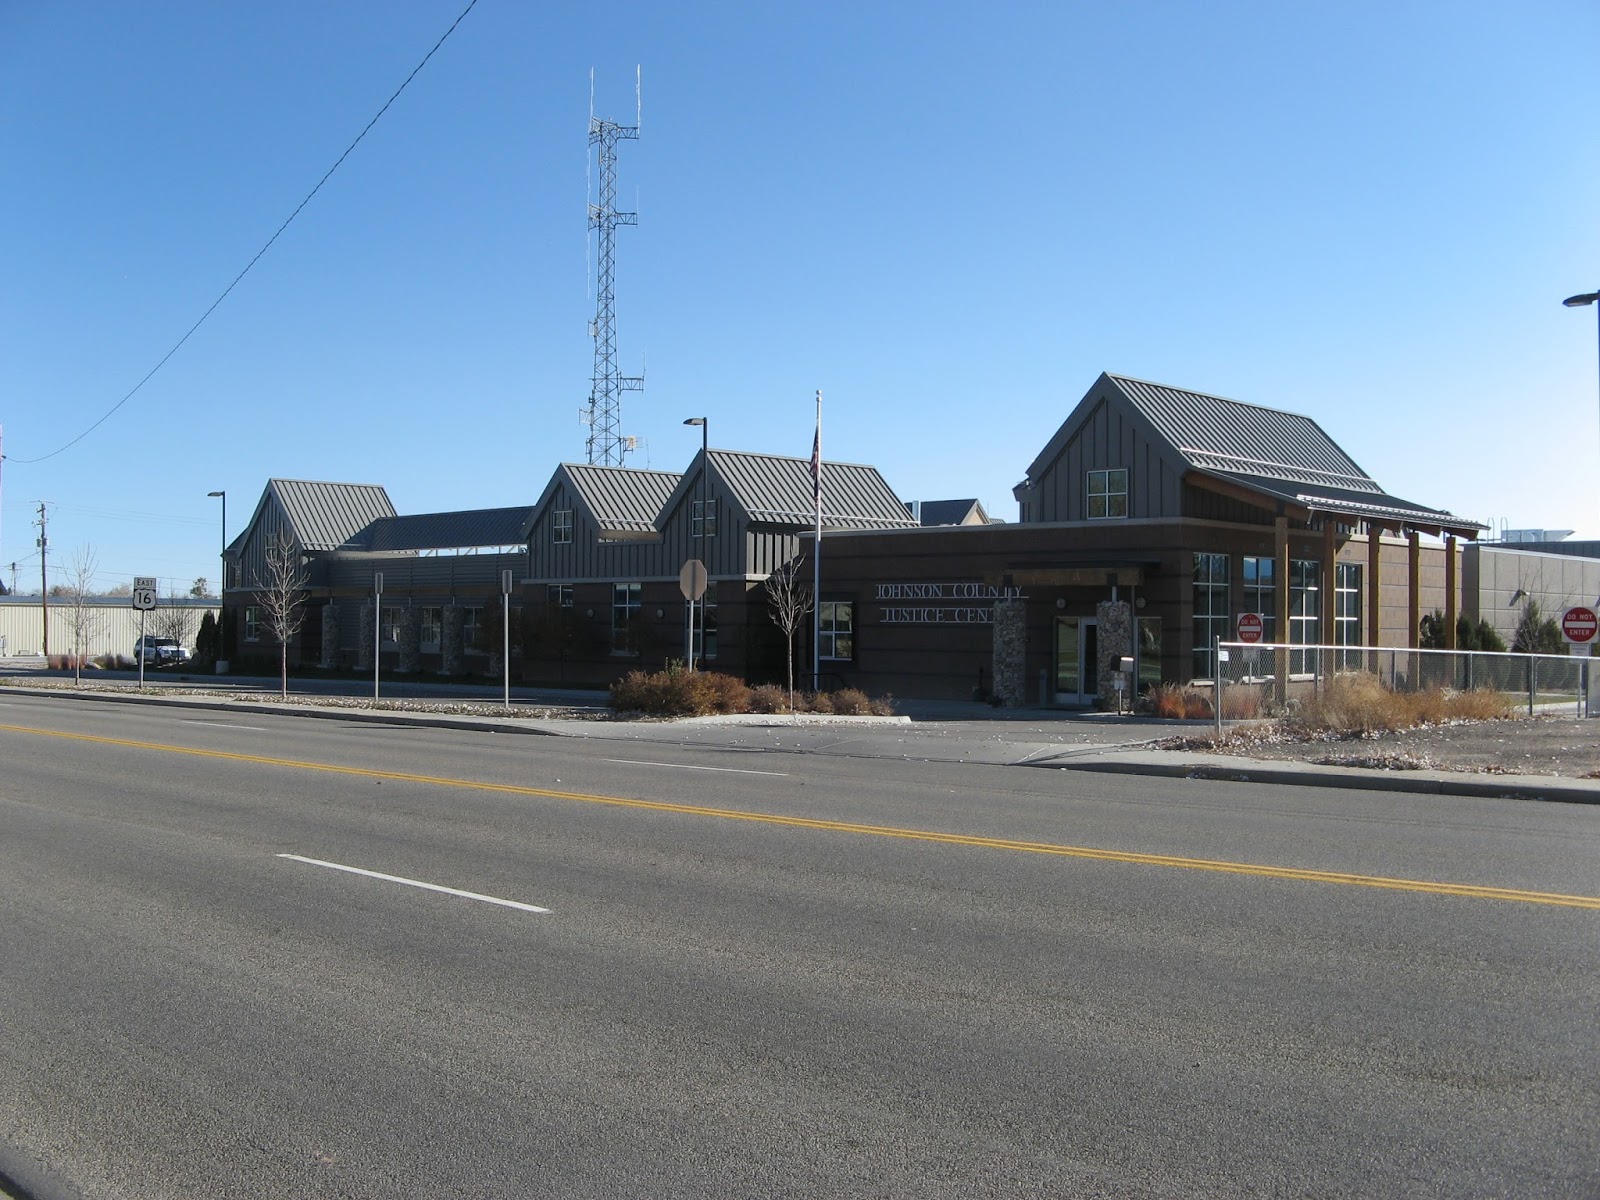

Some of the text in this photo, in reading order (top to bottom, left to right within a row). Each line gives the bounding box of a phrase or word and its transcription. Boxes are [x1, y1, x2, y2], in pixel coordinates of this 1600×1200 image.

[138, 592, 152, 604] 16
[876, 584, 943, 598] JOHNSON
[883, 608, 994, 623] JUSTICE CEN
